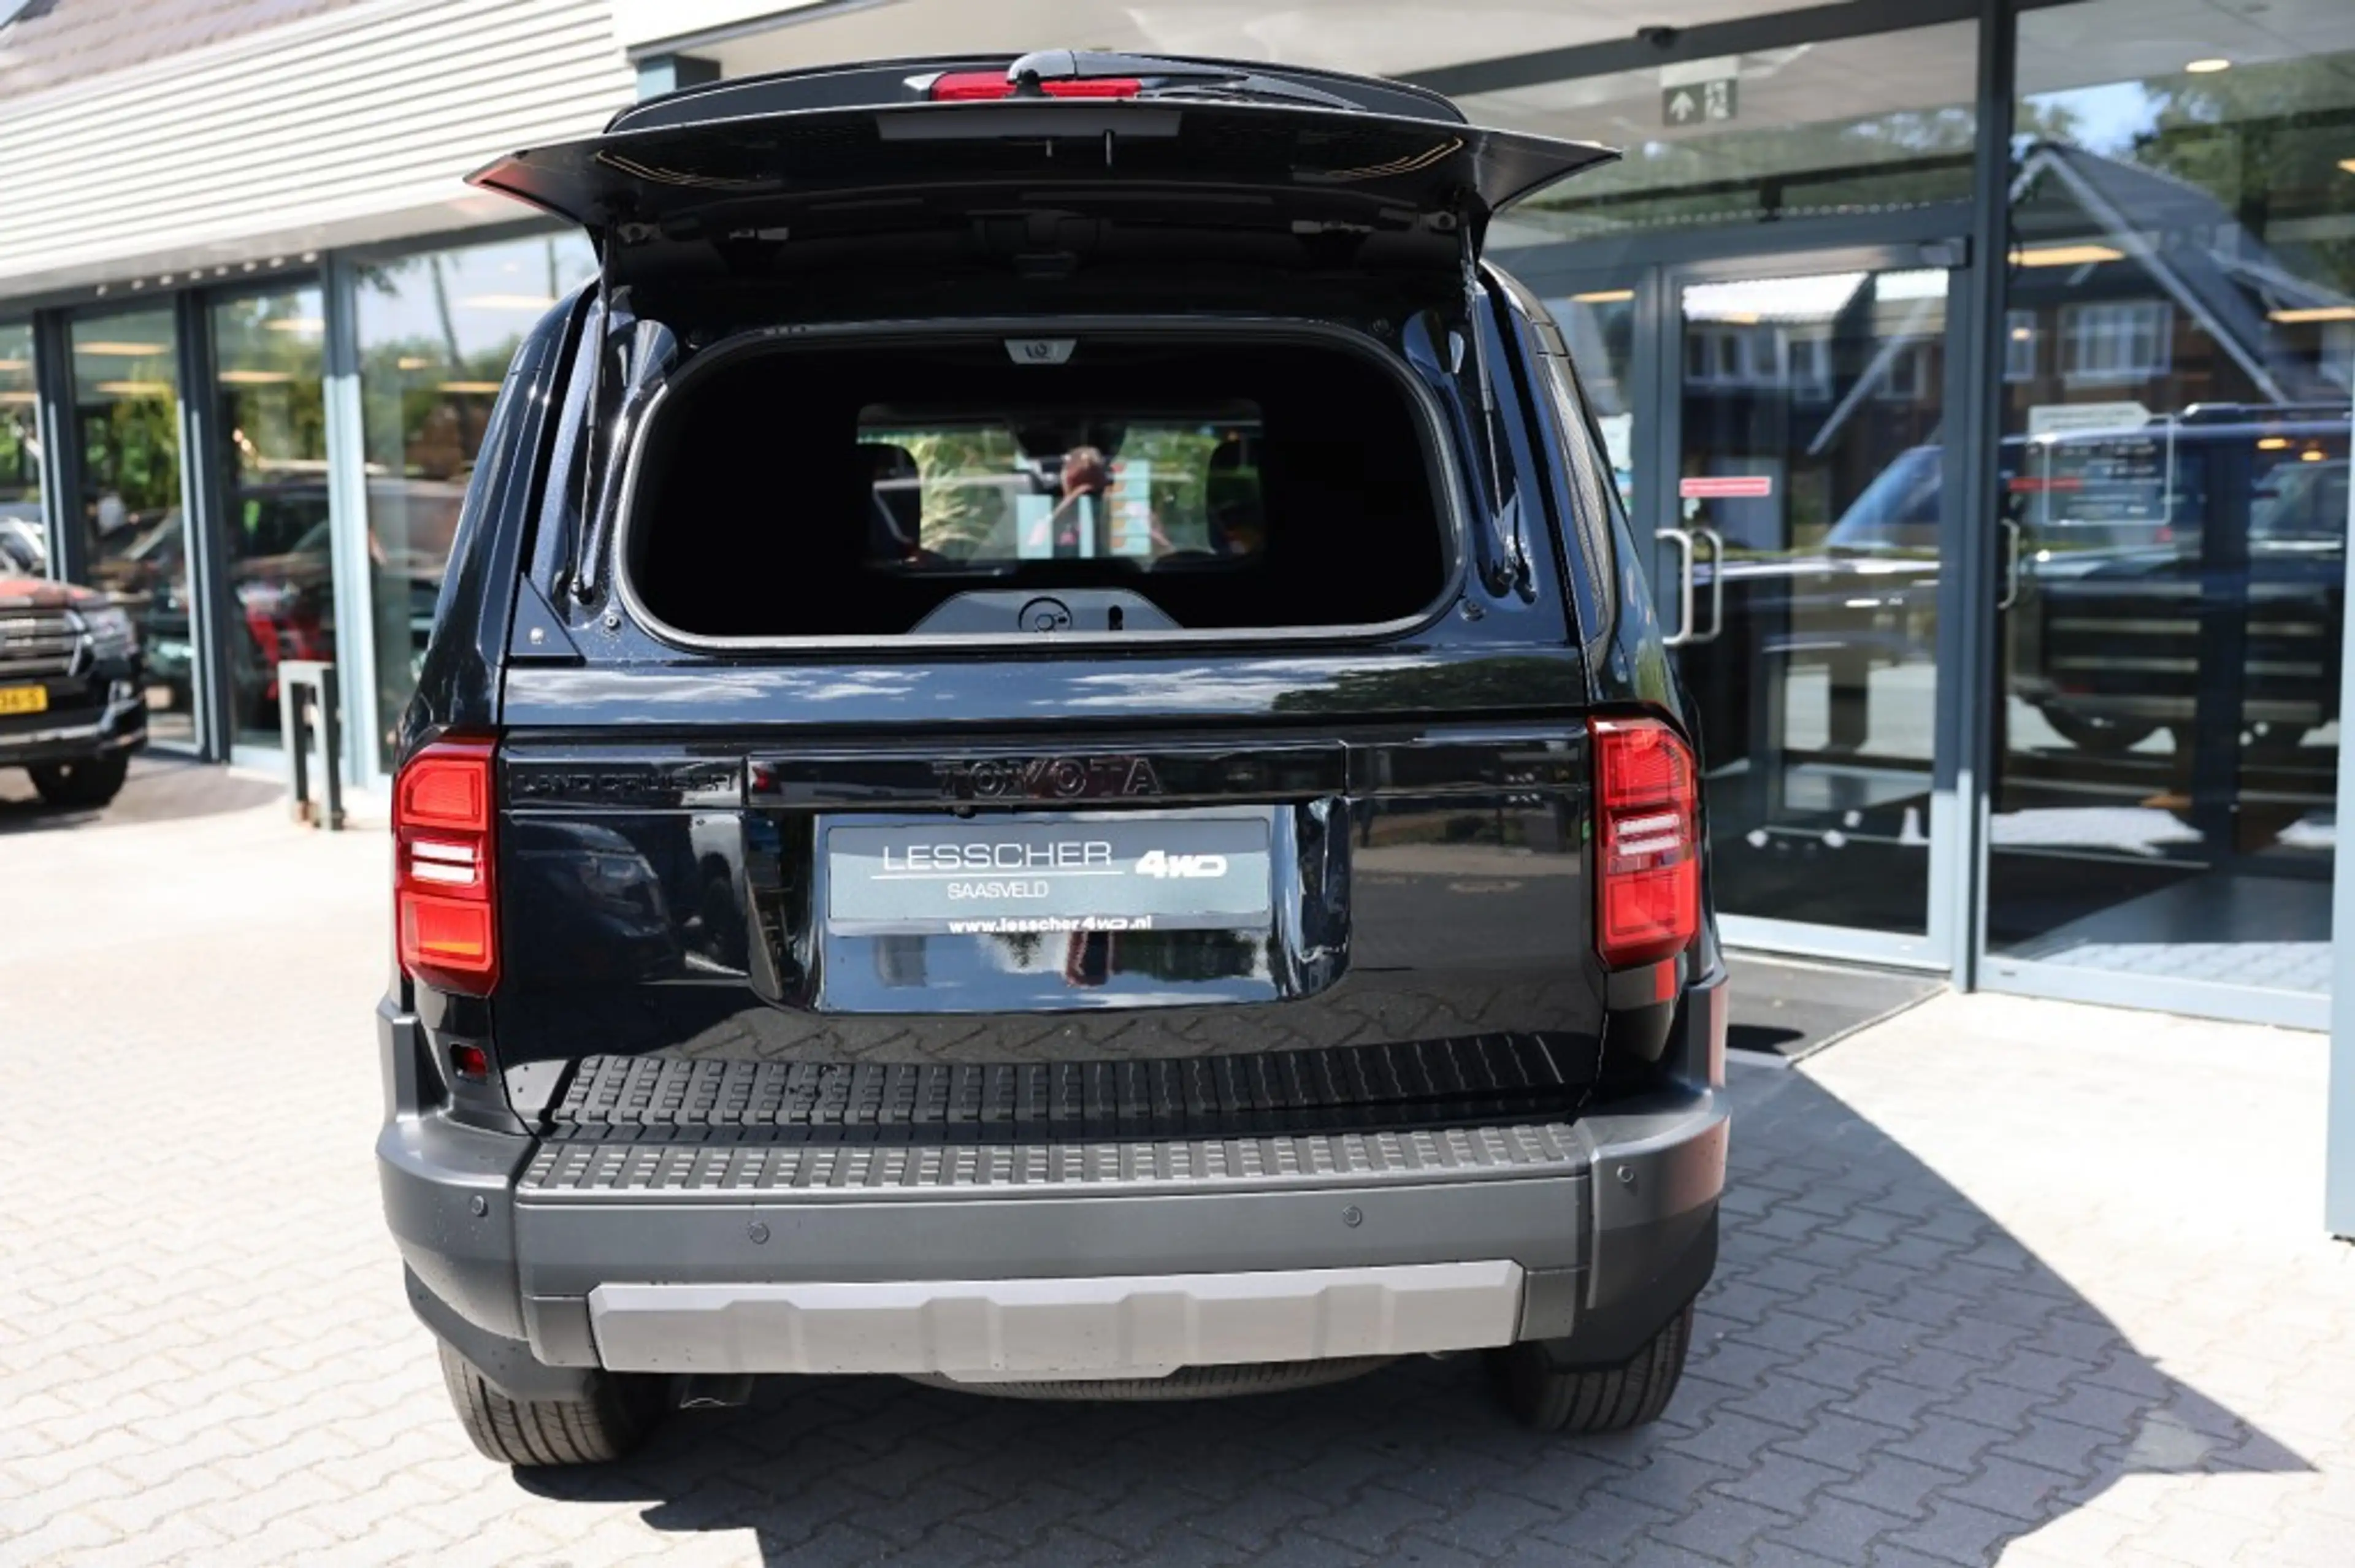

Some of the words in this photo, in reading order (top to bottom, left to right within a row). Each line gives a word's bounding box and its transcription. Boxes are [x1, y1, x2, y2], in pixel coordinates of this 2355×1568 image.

[932, 757, 1163, 798] TOYOTA
[883, 841, 1112, 871] LESSCHER
[1135, 849, 1227, 879] 4WD
[947, 881, 1049, 900] SAASVELD
